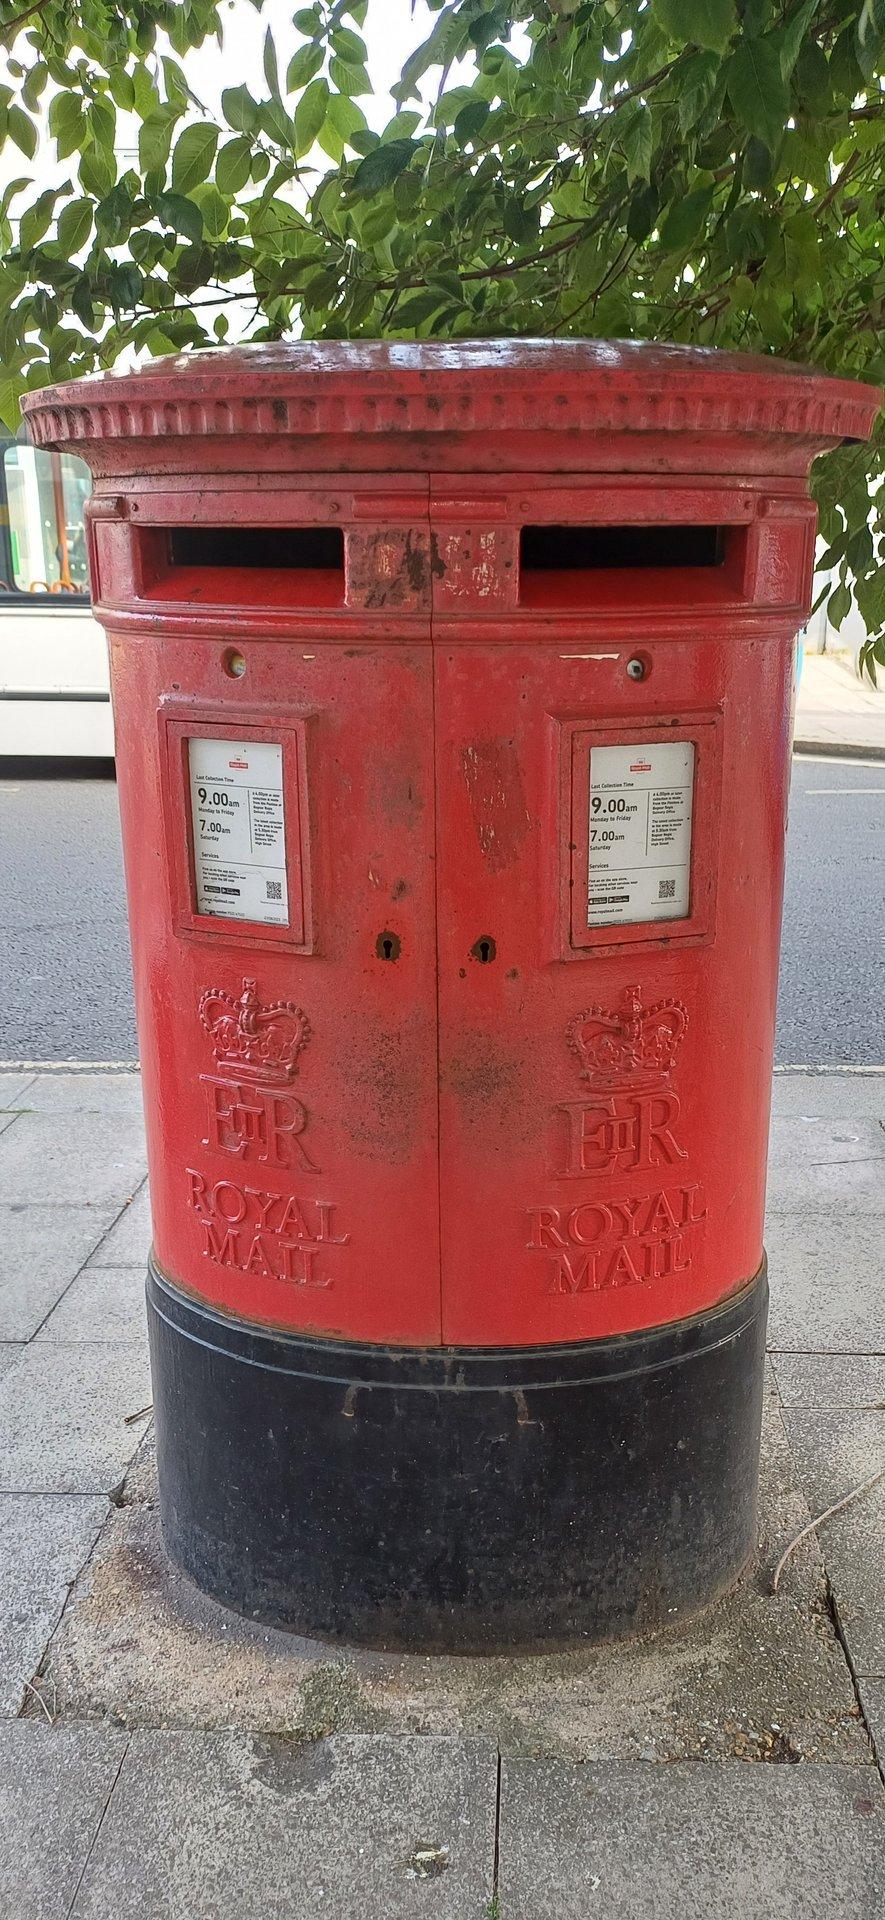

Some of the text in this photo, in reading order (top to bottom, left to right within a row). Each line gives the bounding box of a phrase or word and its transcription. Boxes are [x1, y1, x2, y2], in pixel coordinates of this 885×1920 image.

[198, 788, 240, 808] 9.00am
[591, 797, 638, 814] 9.00am
[199, 819, 231, 834] 7.00am
[590, 830, 625, 842] 7.00am
[200, 834, 219, 842] Saturday
[185, 1167, 350, 1246] ROYAL
[524, 1183, 708, 1250] ROYAL
[201, 1219, 334, 1290] MAIL
[550, 1233, 692, 1294] MAIL
